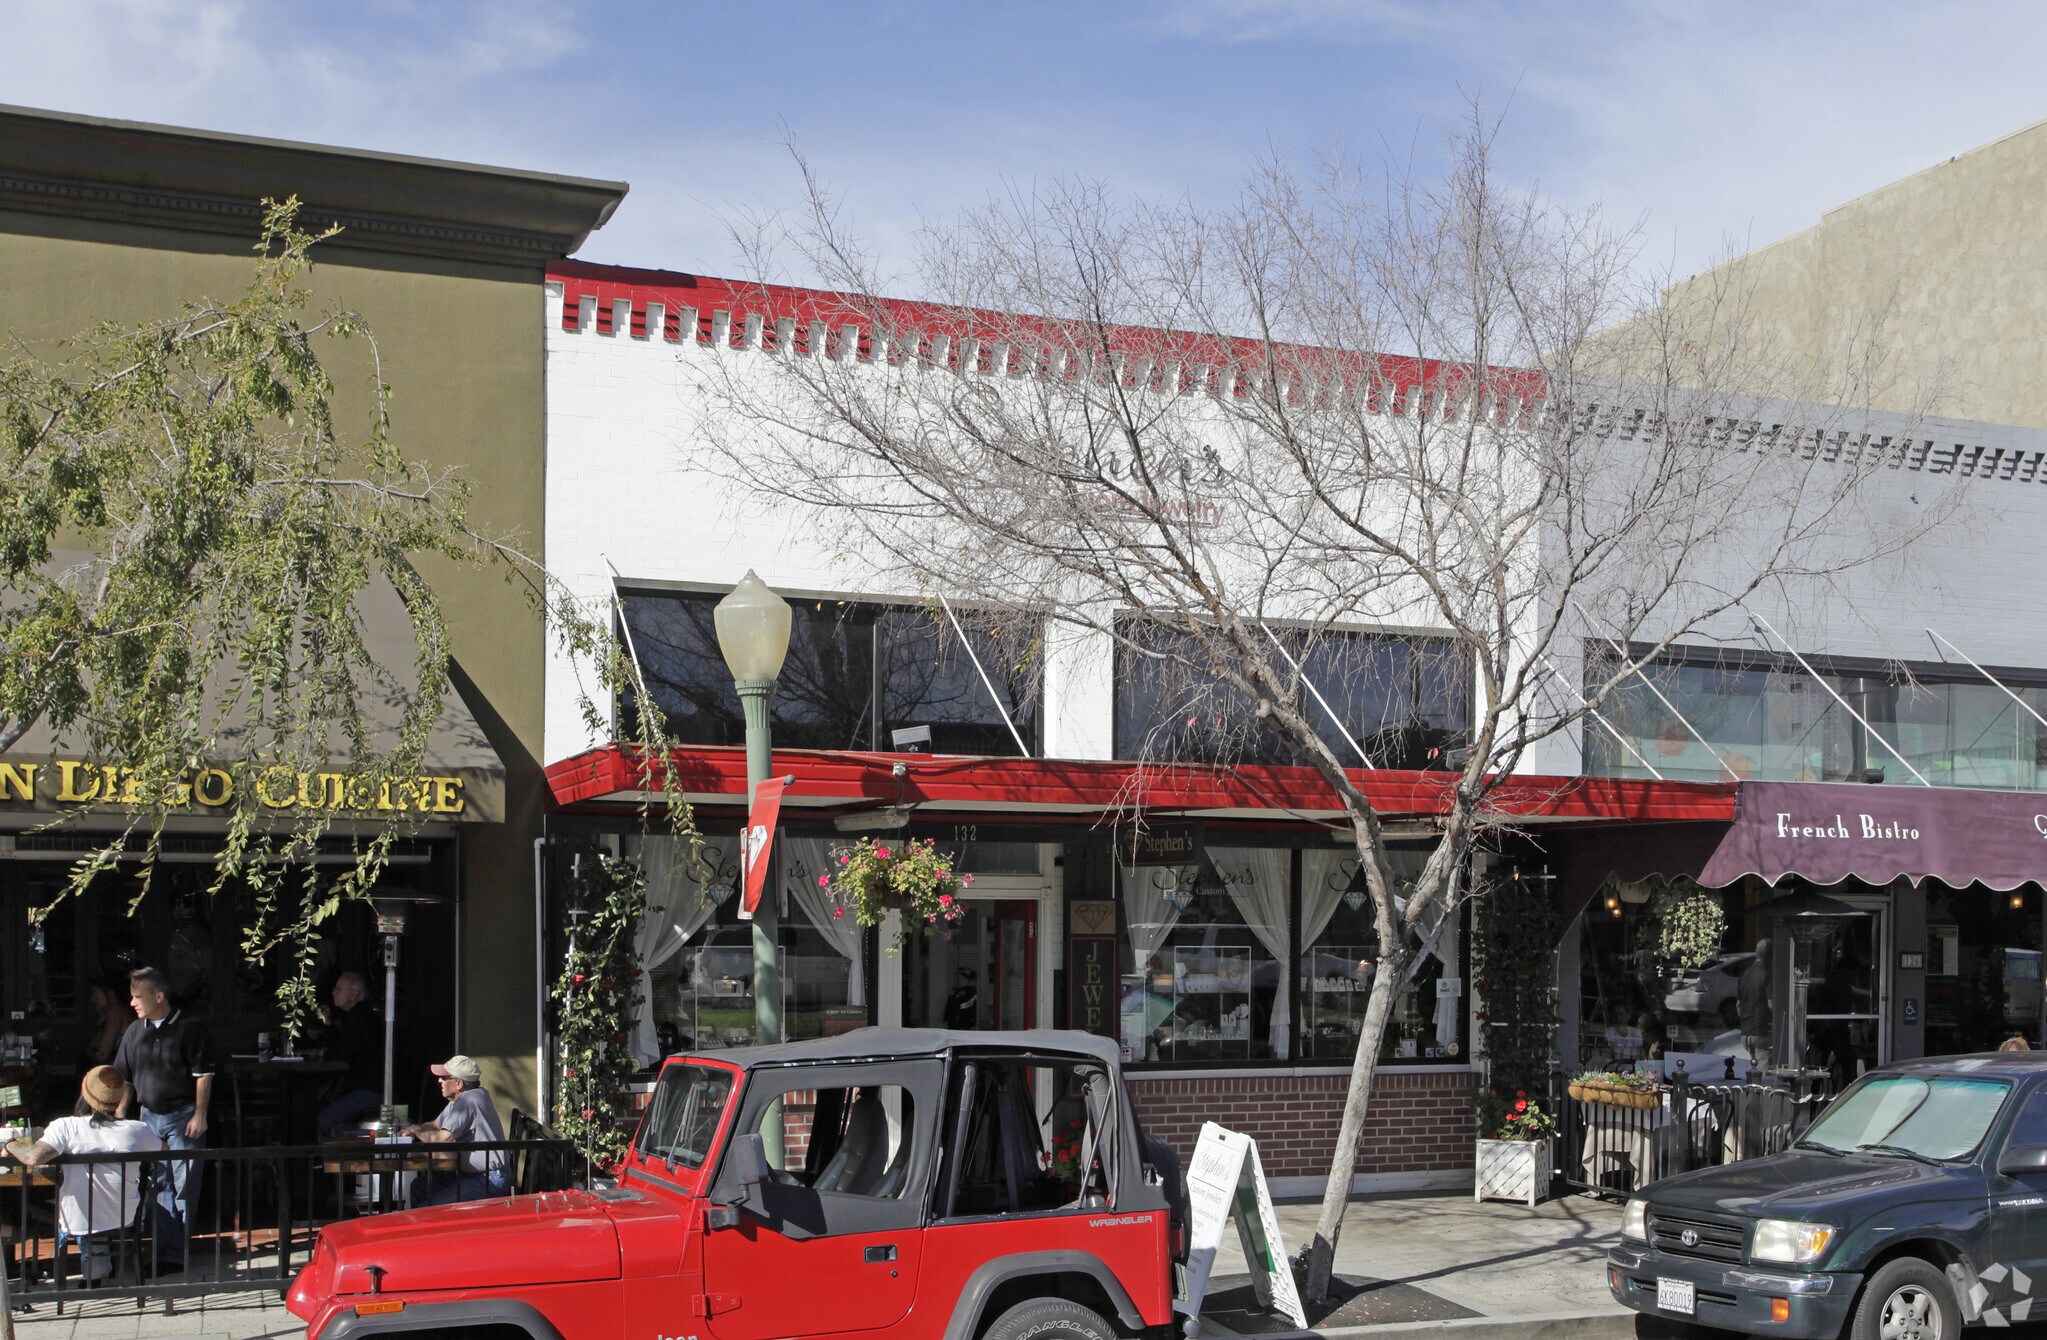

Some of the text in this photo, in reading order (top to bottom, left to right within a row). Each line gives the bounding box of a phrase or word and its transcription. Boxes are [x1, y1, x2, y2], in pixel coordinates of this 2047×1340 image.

[954, 825, 977, 841] 132
[1776, 812, 1920, 840] French Bistro
[1145, 829, 1193, 856] Stephen's
[1196, 886, 1225, 896] Custom
[1082, 942, 1104, 1035] JEWE
[1089, 1215, 1153, 1228] WRANGLER
